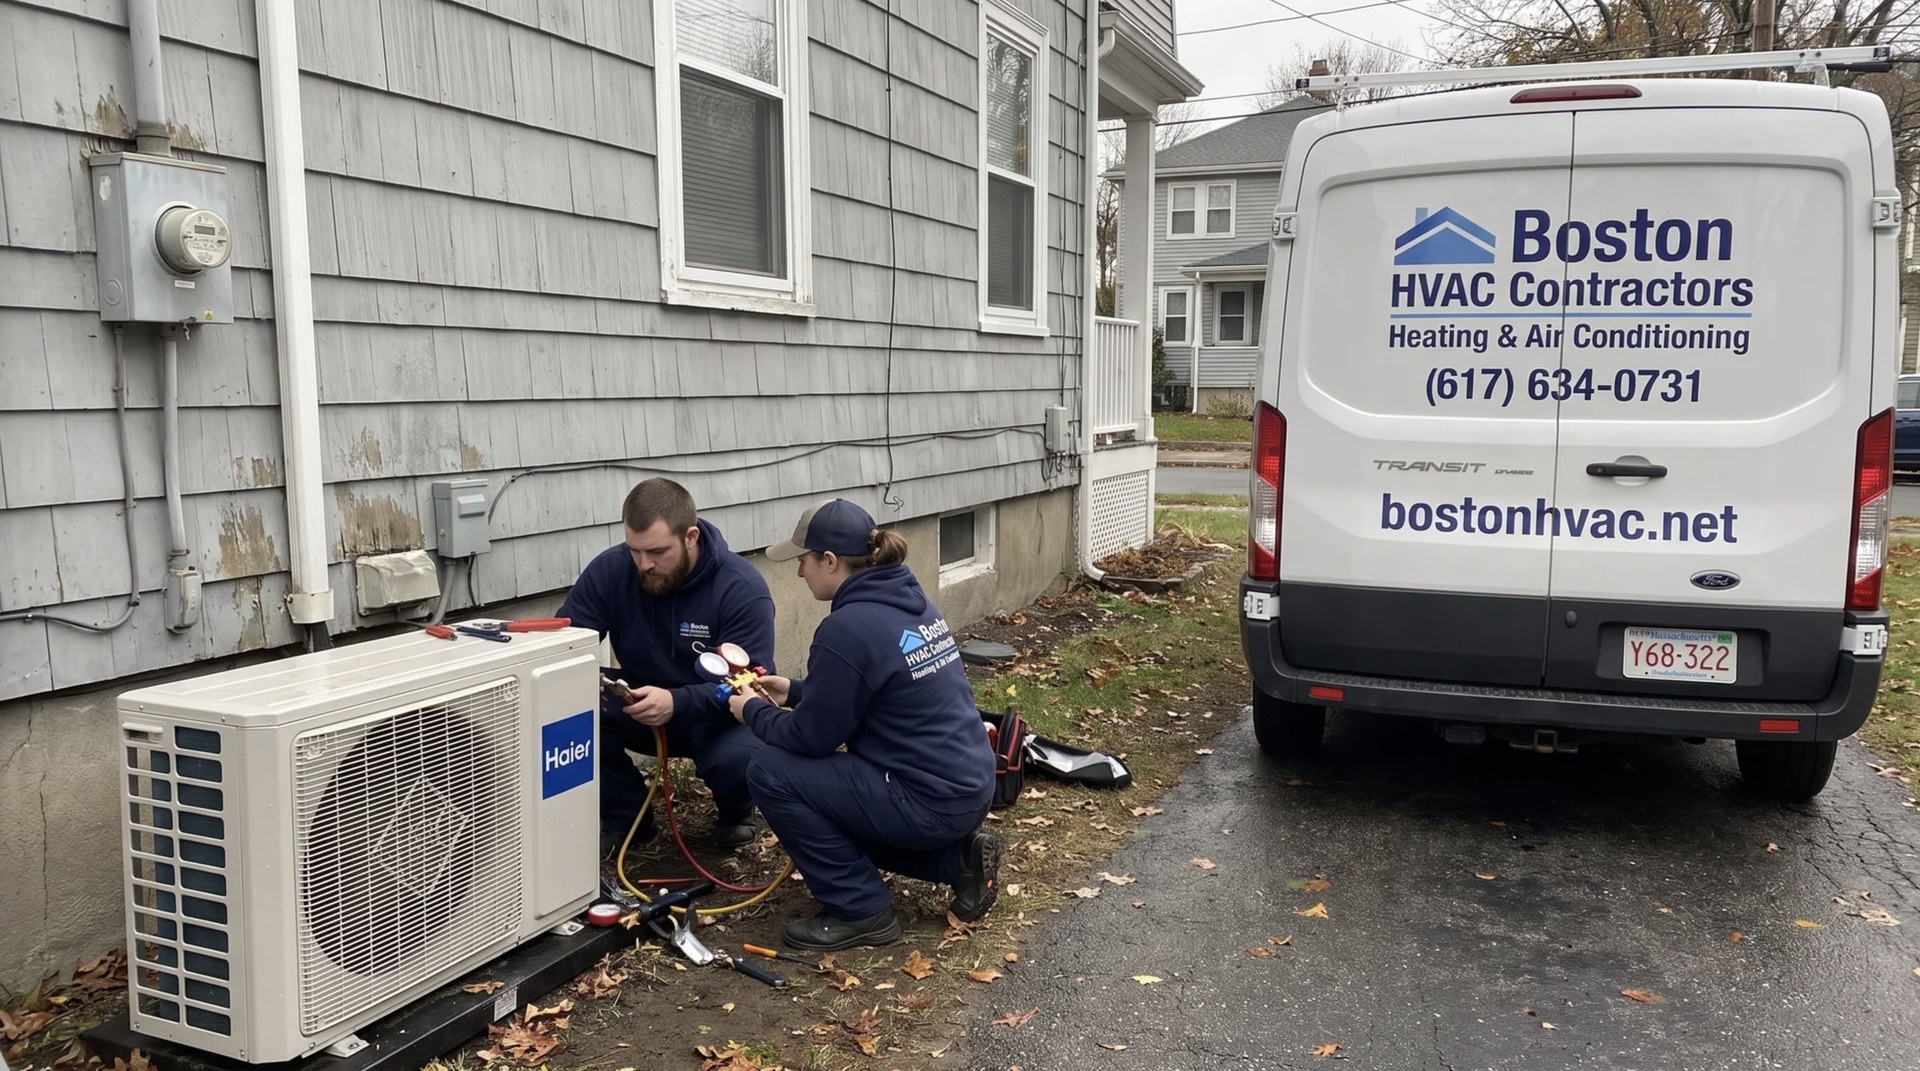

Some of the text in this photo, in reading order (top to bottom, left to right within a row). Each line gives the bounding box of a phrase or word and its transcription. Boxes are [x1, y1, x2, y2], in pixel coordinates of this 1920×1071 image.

[1512, 209, 1733, 263] Boston
[1391, 271, 1753, 307] HVAC Contractors
[1388, 324, 1750, 355] Heating & Air Conditioning
[1426, 367, 1701, 407] (617) 634-0731
[1373, 460, 1486, 473] TRANSIT
[1380, 493, 1738, 543] bostonhvac.net
[1703, 575, 1729, 586] Ford
[905, 646, 932, 667] HVAC
[1631, 640, 1730, 671] Y68-322
[545, 739, 591, 773] Haier
